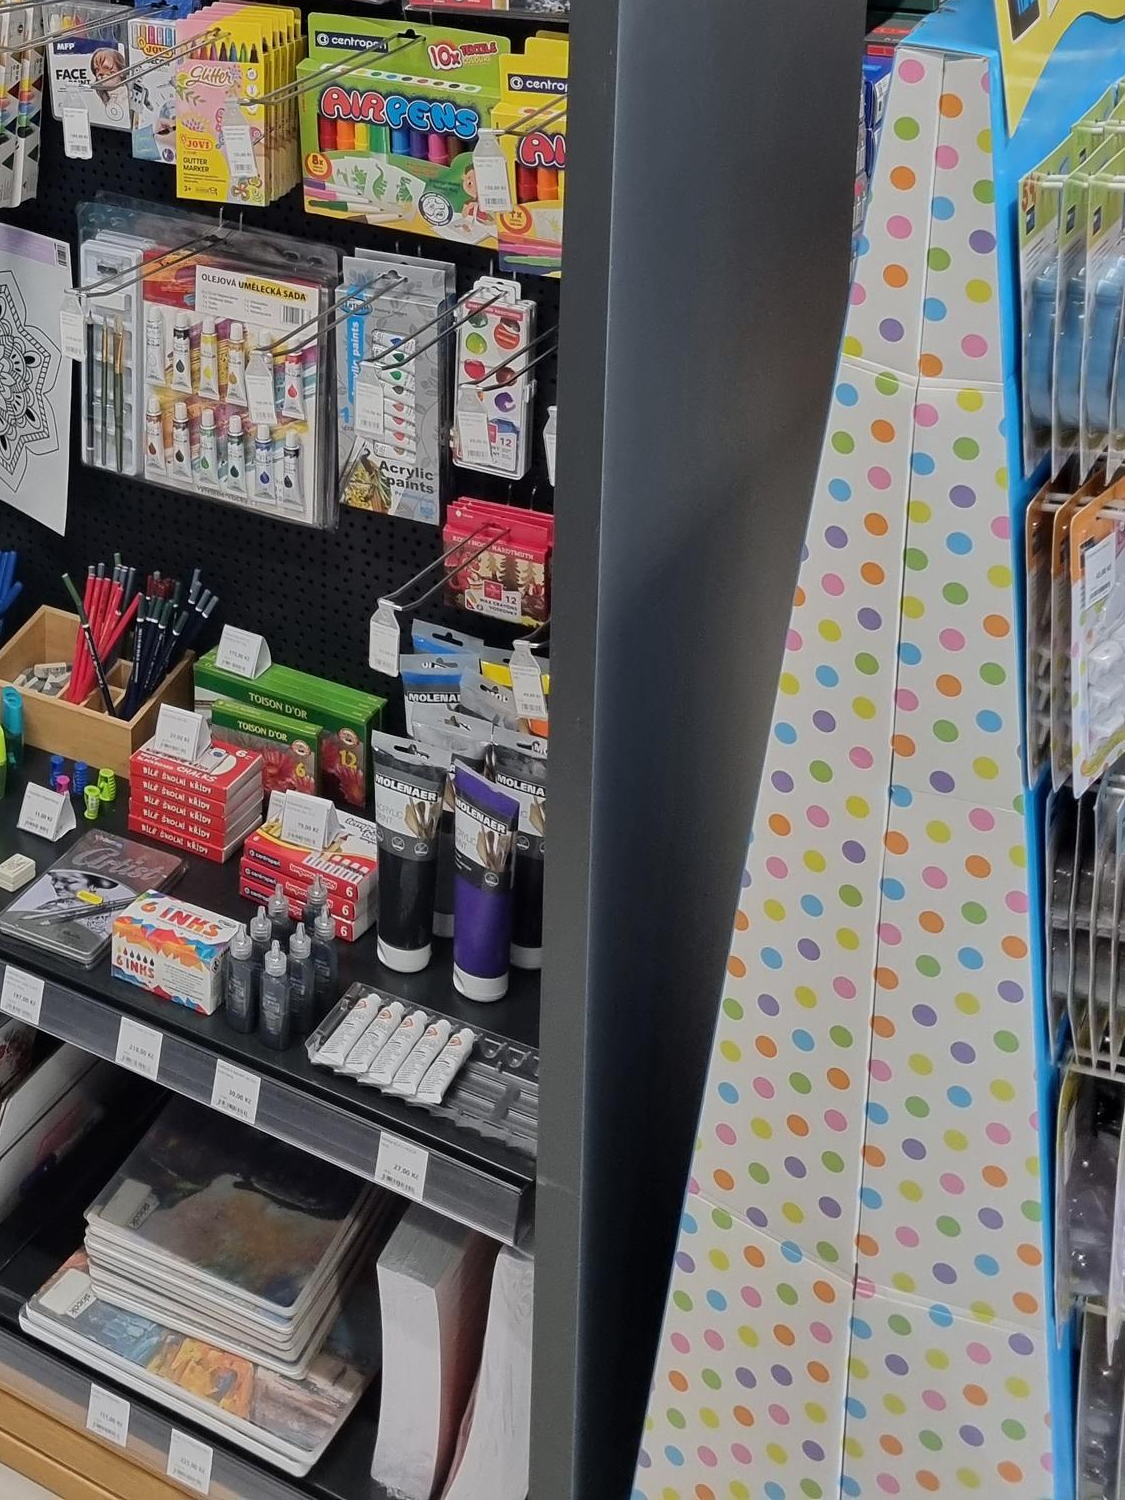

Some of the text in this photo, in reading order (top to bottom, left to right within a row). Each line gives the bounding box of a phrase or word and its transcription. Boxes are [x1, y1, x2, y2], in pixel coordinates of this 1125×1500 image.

[57, 42, 75, 51] MFP
[429, 45, 461, 70] 10x
[55, 68, 87, 80] FACE
[185, 65, 235, 88] Glitter
[187, 140, 211, 149] JOVI
[183, 164, 209, 173] MARKER
[201, 272, 307, 302] OLEJOVÁ UMĚLECKÁ SADA
[350, 321, 360, 355] paints
[499, 437, 513, 448] 12
[379, 460, 434, 482] Acrylic
[386, 474, 434, 495] paints
[505, 595, 518, 605] 12
[248, 691, 308, 721] TOISON D'OR
[237, 719, 288, 742] TOISON D'OR
[295, 760, 306, 777] 6
[339, 749, 357, 771] 12
[176, 765, 218, 783] CHALKS
[375, 774, 438, 802] MOLENAER
[71, 847, 168, 881] Artist
[345, 886, 353, 898] 6
[141, 901, 223, 938] 6 INKS
[341, 904, 350, 916] 6
[340, 925, 348, 937] 6
[116, 955, 156, 980] 6 INKS
